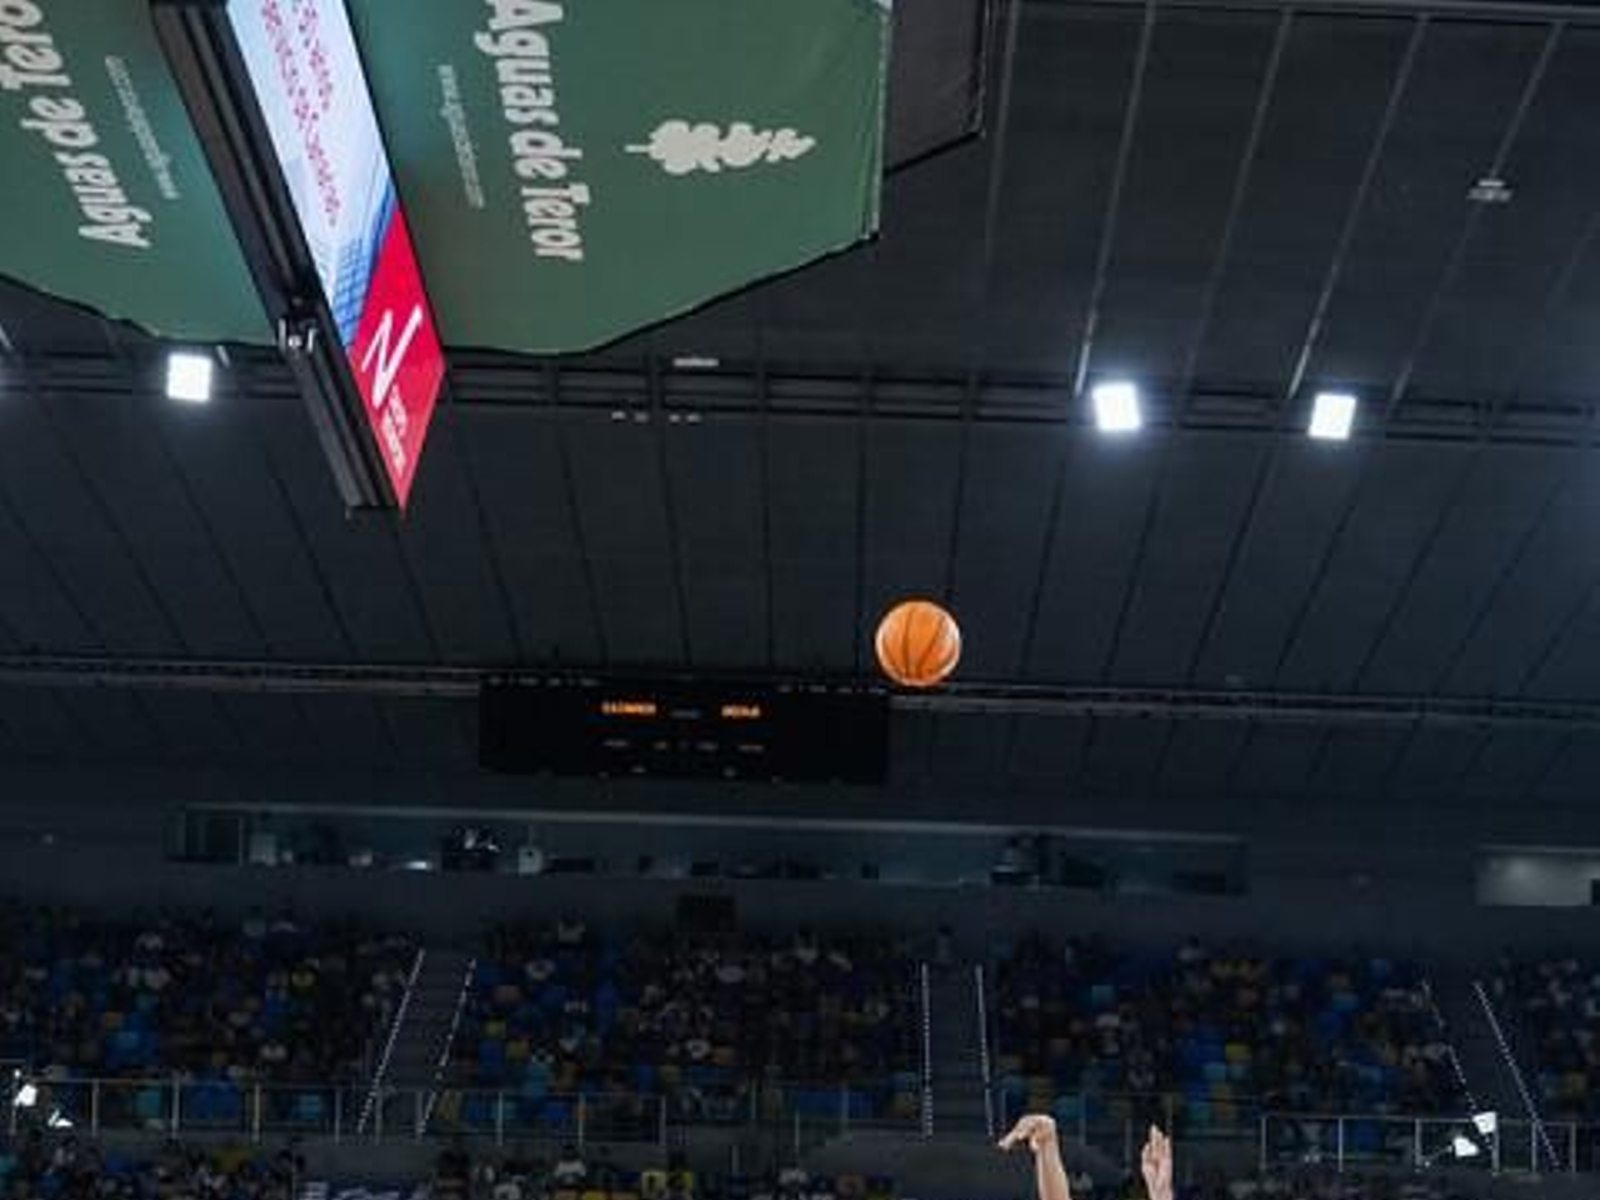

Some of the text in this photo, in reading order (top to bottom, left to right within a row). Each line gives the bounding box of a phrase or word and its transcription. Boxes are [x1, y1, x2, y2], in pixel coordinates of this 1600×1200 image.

[0, 0, 71, 90] Tero
[20, 96, 98, 147] de
[474, 0, 590, 260] Aguas de Teror
[55, 152, 152, 248] Aguas
